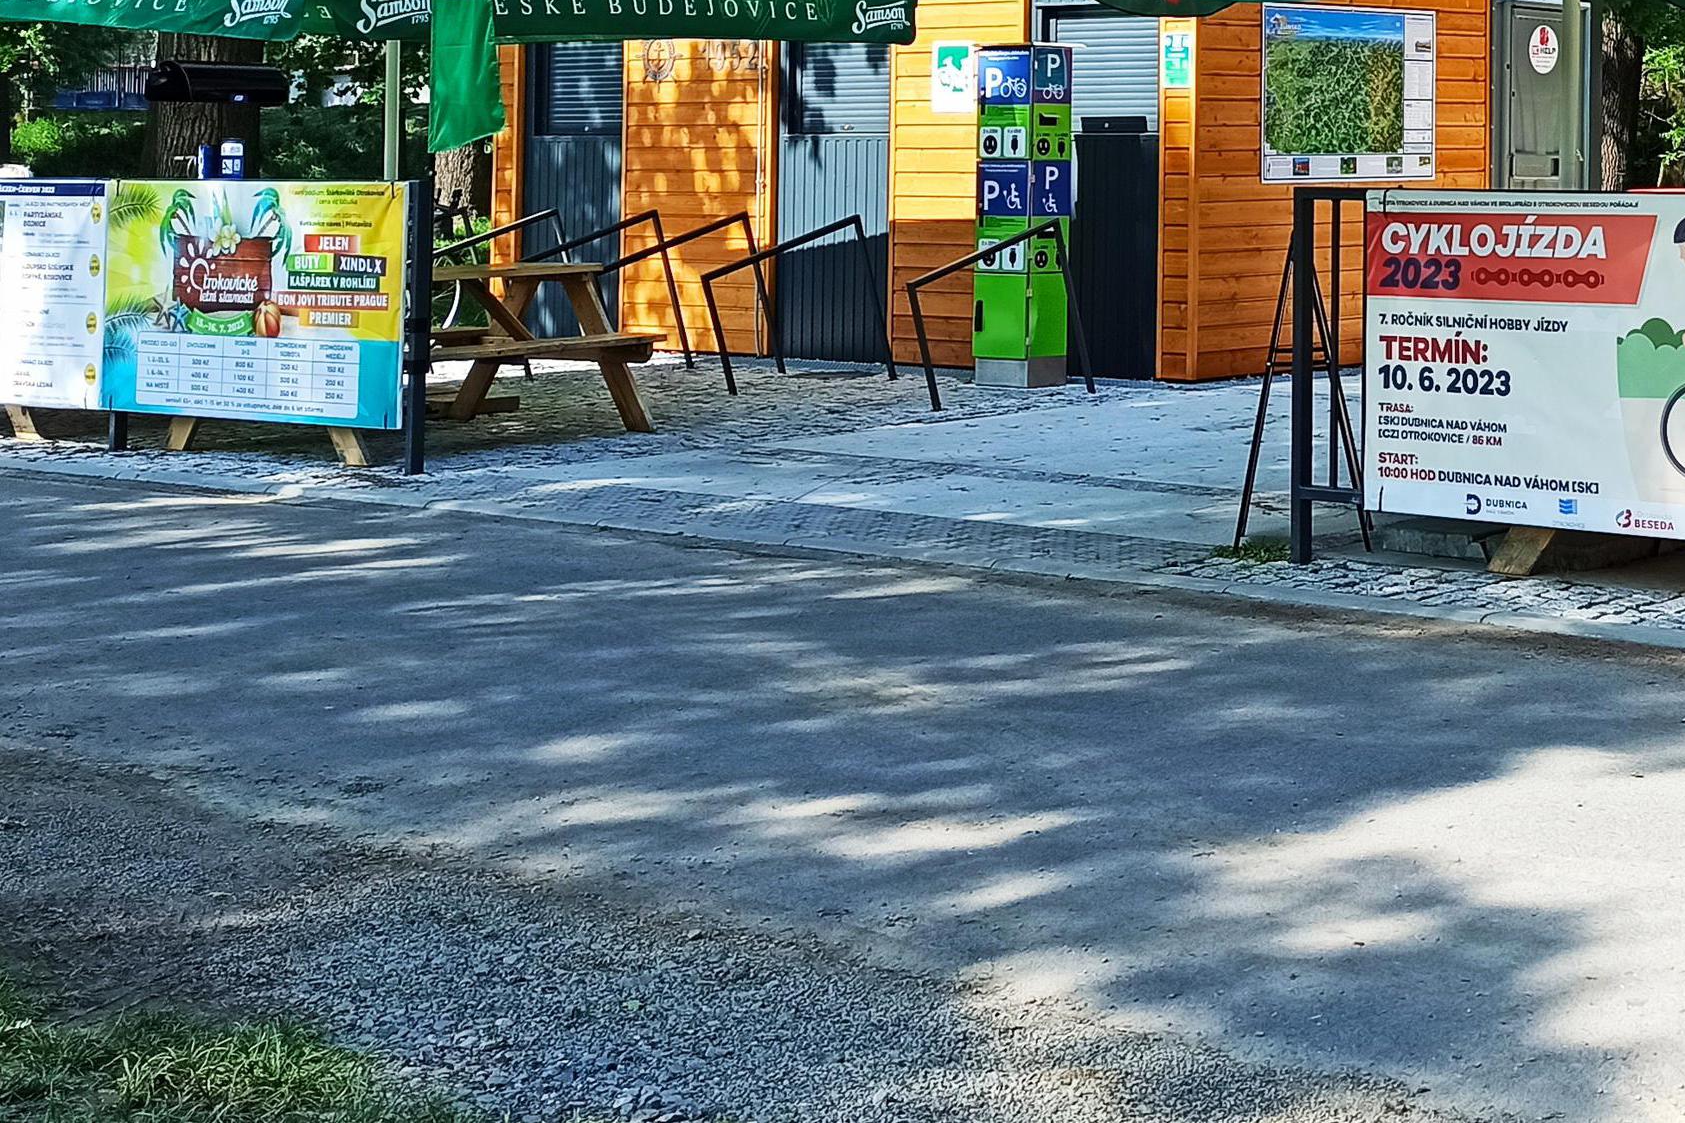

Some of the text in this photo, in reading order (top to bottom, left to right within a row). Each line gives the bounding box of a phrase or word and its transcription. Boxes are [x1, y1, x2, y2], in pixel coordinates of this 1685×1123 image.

[411, 13, 430, 26] 1795
[851, 0, 911, 35] Samson
[1047, 53, 1060, 78] P
[985, 67, 1003, 98] P
[1045, 166, 1059, 190] P
[983, 180, 1000, 211] P
[318, 236, 349, 251] JELEN
[1381, 214, 1608, 259] CYKLOJÍZDA
[294, 255, 321, 269] BUTY
[289, 273, 377, 289] KAŠPÁREK V ROHLÍKU
[1379, 256, 1462, 291] 2023
[277, 294, 388, 307] BON JOVI TRIBUTE PRAGUE
[308, 312, 352, 325] PREMIER
[1378, 311, 1569, 333] 7. ROČNÍK SILNIČNÍ HOBBY JÍZDY
[1378, 330, 1489, 365] TERMÍN:
[1377, 364, 1512, 397] 10. 6. 2023
[1378, 402, 1414, 414] TRASA:
[1378, 415, 1508, 434] [SK] DUBNICA NAD VÁHOM
[1378, 428, 1400, 439] [CZ]
[1400, 430, 1464, 444] OTROKOVICE
[1471, 435, 1484, 446] 86
[1485, 436, 1503, 447] KM
[1378, 451, 1419, 465] START:
[1377, 466, 1600, 495] 10:00 HOD DUBNICA NAD VÁHOM [SK]
[1485, 498, 1529, 510] DUBNICA
[1634, 518, 1675, 531] BESEDA
